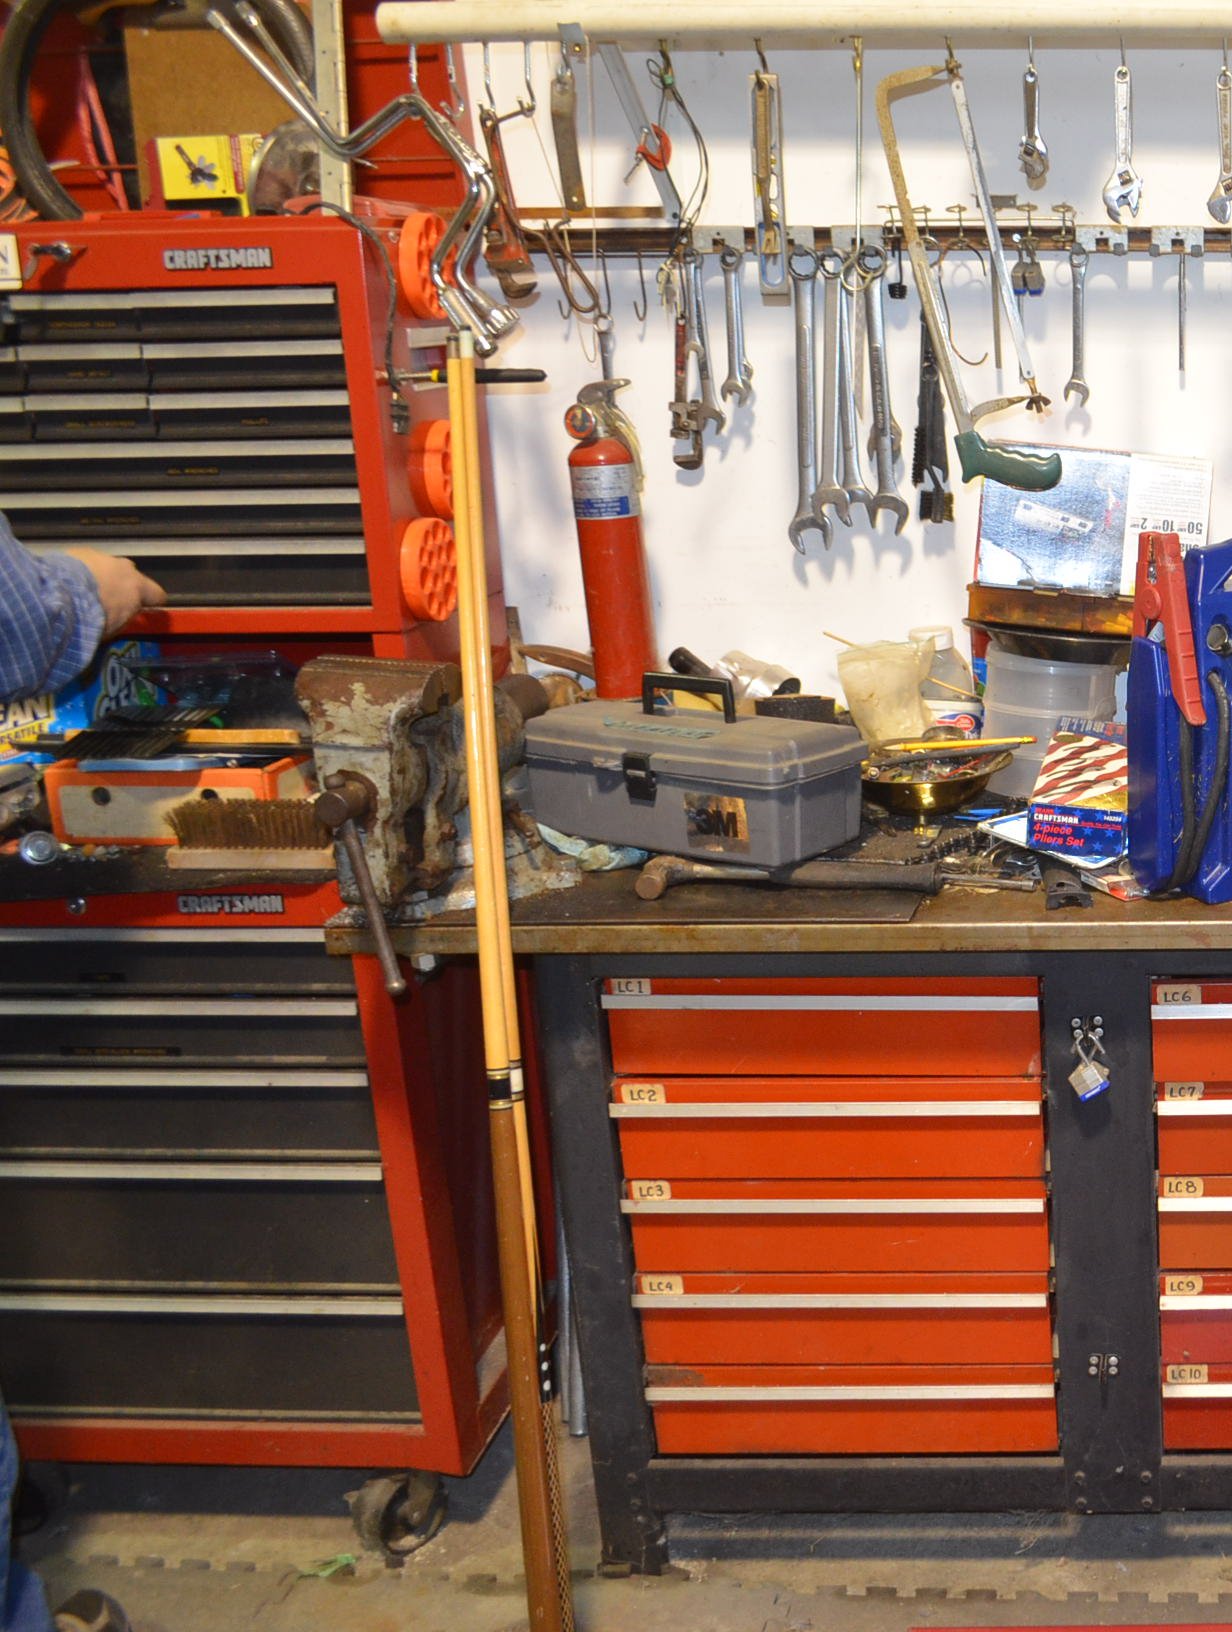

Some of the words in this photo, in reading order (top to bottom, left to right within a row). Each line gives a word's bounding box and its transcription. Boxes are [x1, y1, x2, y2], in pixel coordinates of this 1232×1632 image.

[163, 247, 273, 269] CRAFTSMAN
[1140, 517, 1148, 530] 2
[1162, 520, 1175, 532] 10
[1187, 522, 1203, 534] 50
[1033, 813, 1079, 824] CRAFTSMAN
[1033, 823, 1073, 835] 4-piece
[1034, 833, 1063, 846] Pliers
[1066, 836, 1085, 847] Set
[178, 895, 283, 913] CRAFTSMAN
[639, 1184, 664, 1197] LC3
